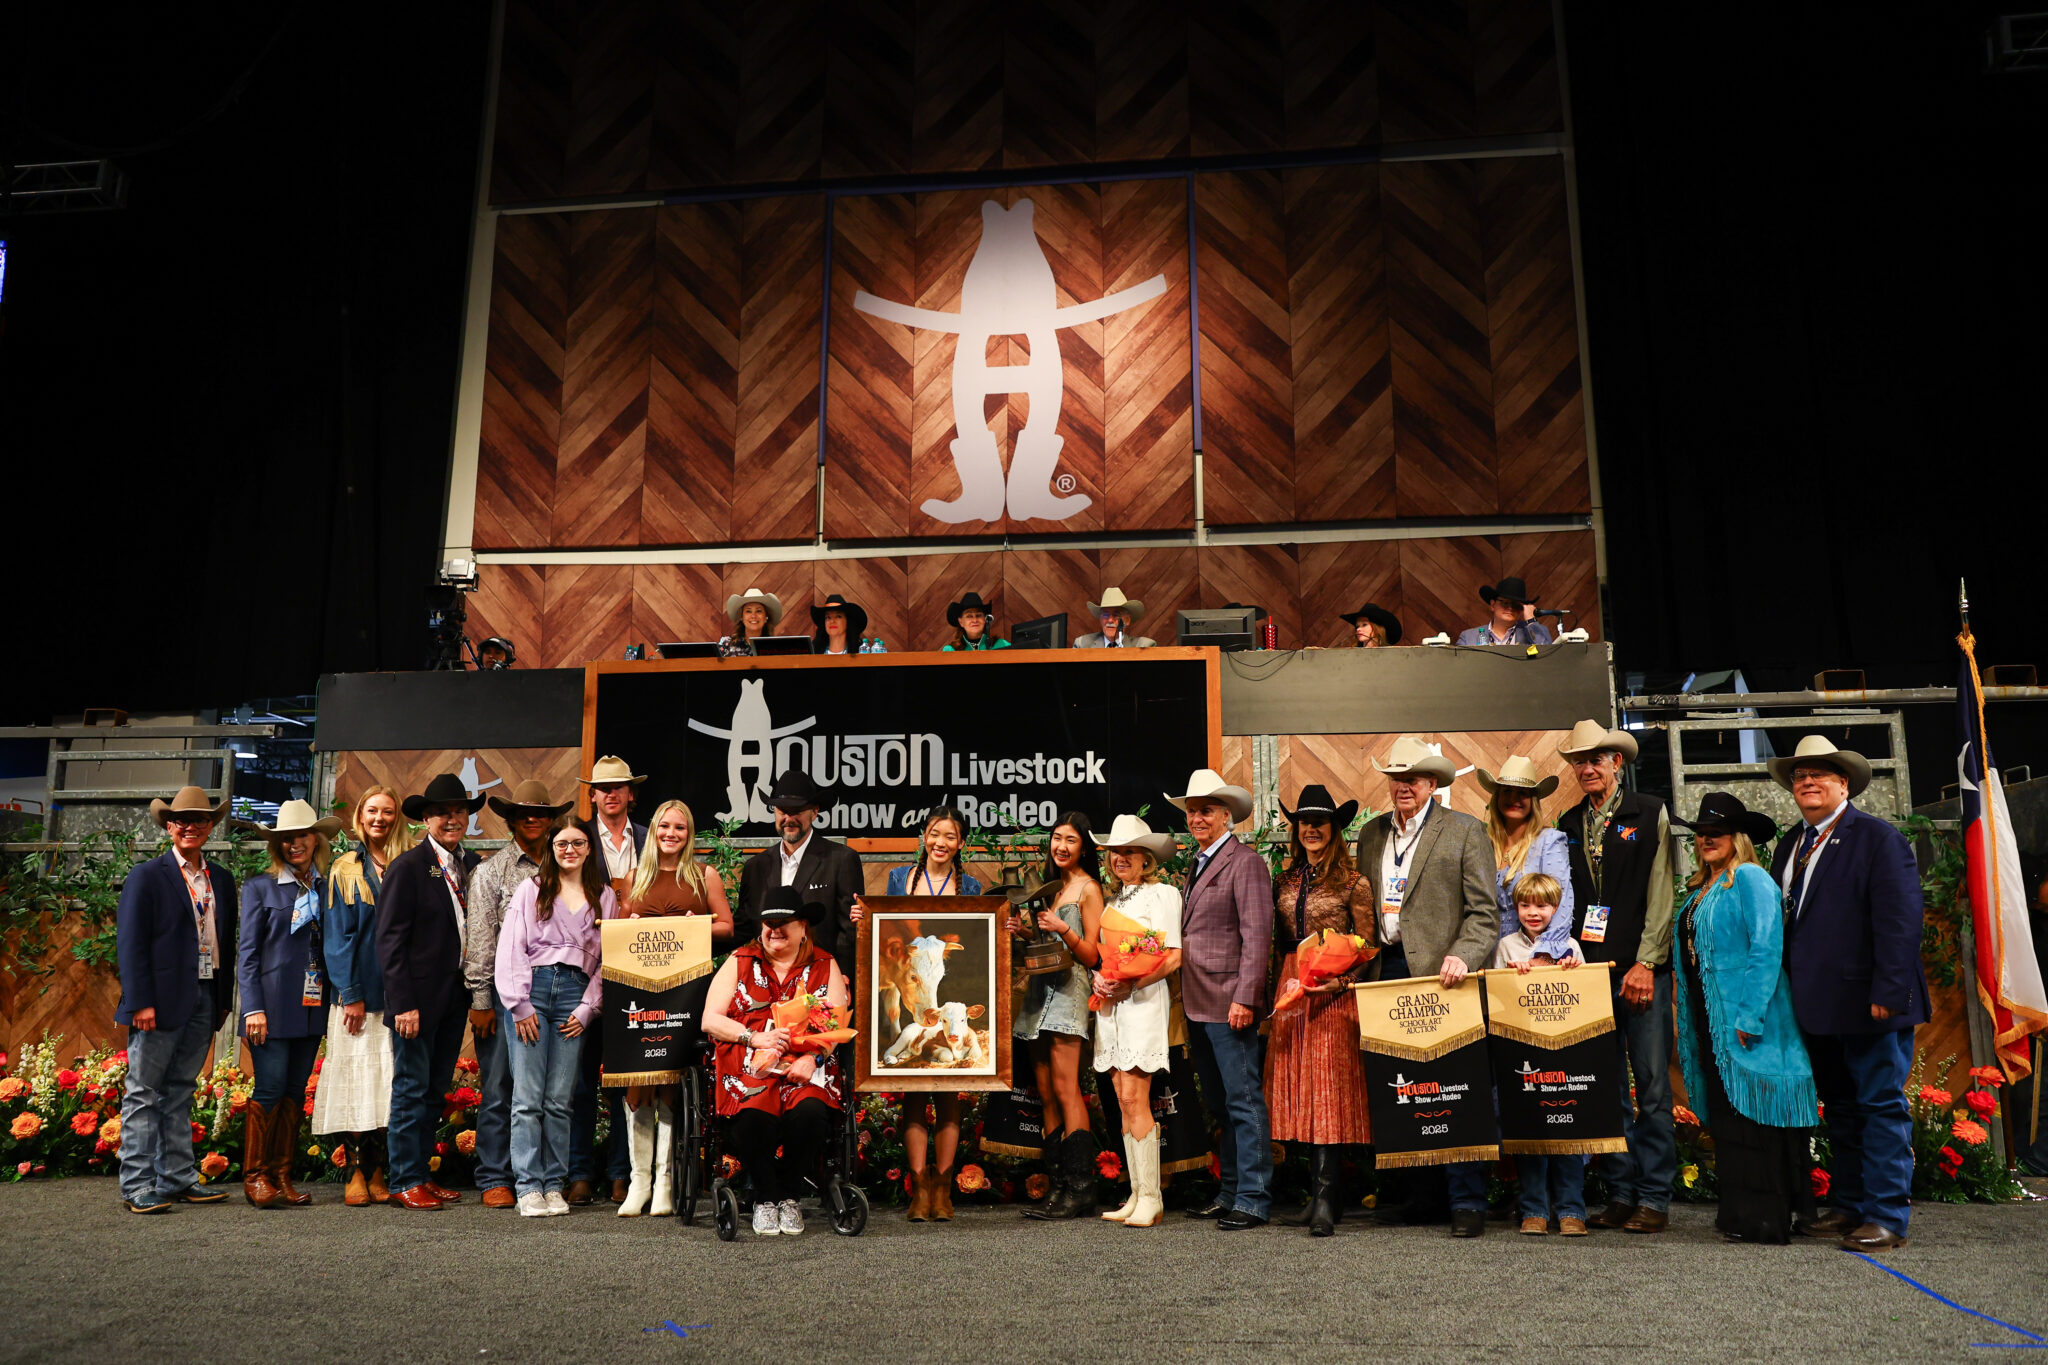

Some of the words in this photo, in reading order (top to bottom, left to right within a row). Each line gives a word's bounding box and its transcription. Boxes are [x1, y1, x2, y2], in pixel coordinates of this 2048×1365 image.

[951, 751, 1106, 786] Livestock
[957, 794, 1058, 828] Rodeo
[637, 931, 675, 942] GRAND
[629, 941, 684, 954] CHAMPION
[1526, 982, 1569, 995] GRAND
[1397, 993, 1440, 1008] GRAND
[1518, 993, 1580, 1007] CHAMPION
[666, 1011, 691, 1020] Livestock
[1389, 1003, 1451, 1021] CHAMPION
[1557, 1007, 1571, 1015] ART
[1400, 1018, 1428, 1028] SCHOOL
[1428, 1017, 1443, 1026] ART
[1534, 1014, 1566, 1022] AUCTION
[1406, 1025, 1437, 1034] AUCTION
[644, 1048, 667, 1058] 2025
[1565, 1074, 1596, 1083] Livestock
[1439, 1083, 1469, 1093] Livestock
[1540, 1084, 1557, 1092] Show
[1568, 1083, 1588, 1091] Rodeo
[1415, 1095, 1432, 1104] Show
[1442, 1093, 1462, 1101] Rodeo
[1546, 1114, 1574, 1124] 2025
[1421, 1124, 1448, 1135] 2025
